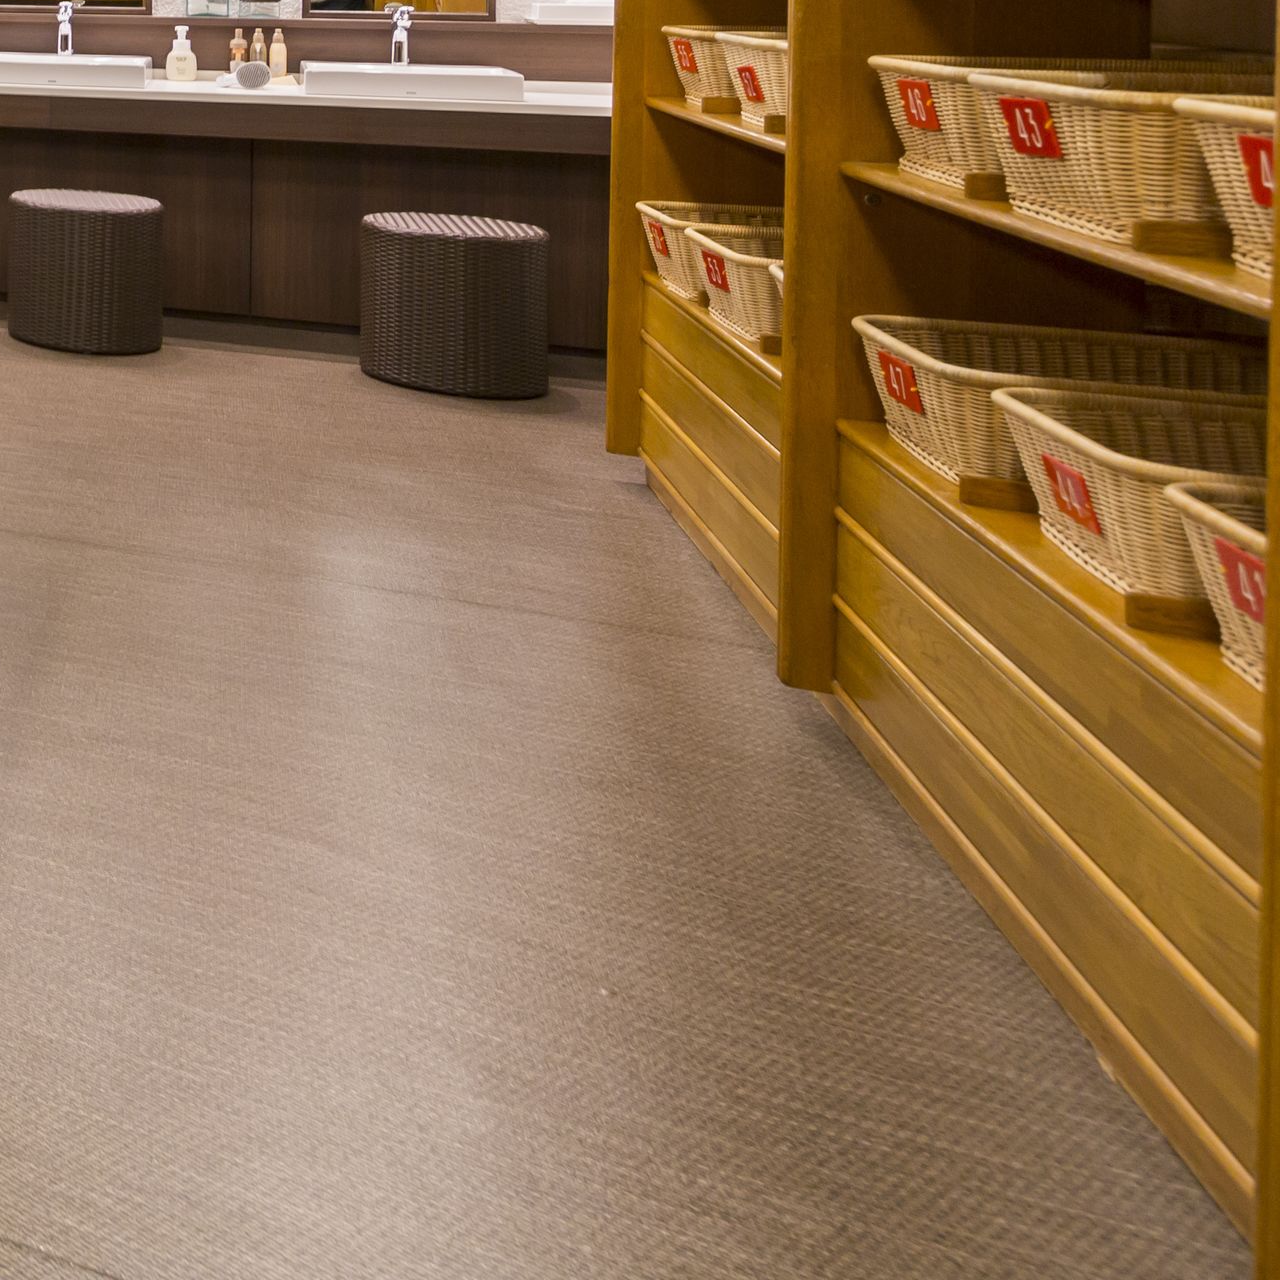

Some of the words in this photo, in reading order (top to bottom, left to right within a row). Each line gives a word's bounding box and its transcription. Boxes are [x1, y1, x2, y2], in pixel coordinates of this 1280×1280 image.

[907, 88, 926, 122] 46
[1015, 108, 1043, 148] 43
[1260, 149, 1277, 192] 4
[889, 363, 907, 400] 47
[1055, 469, 1085, 518] 44
